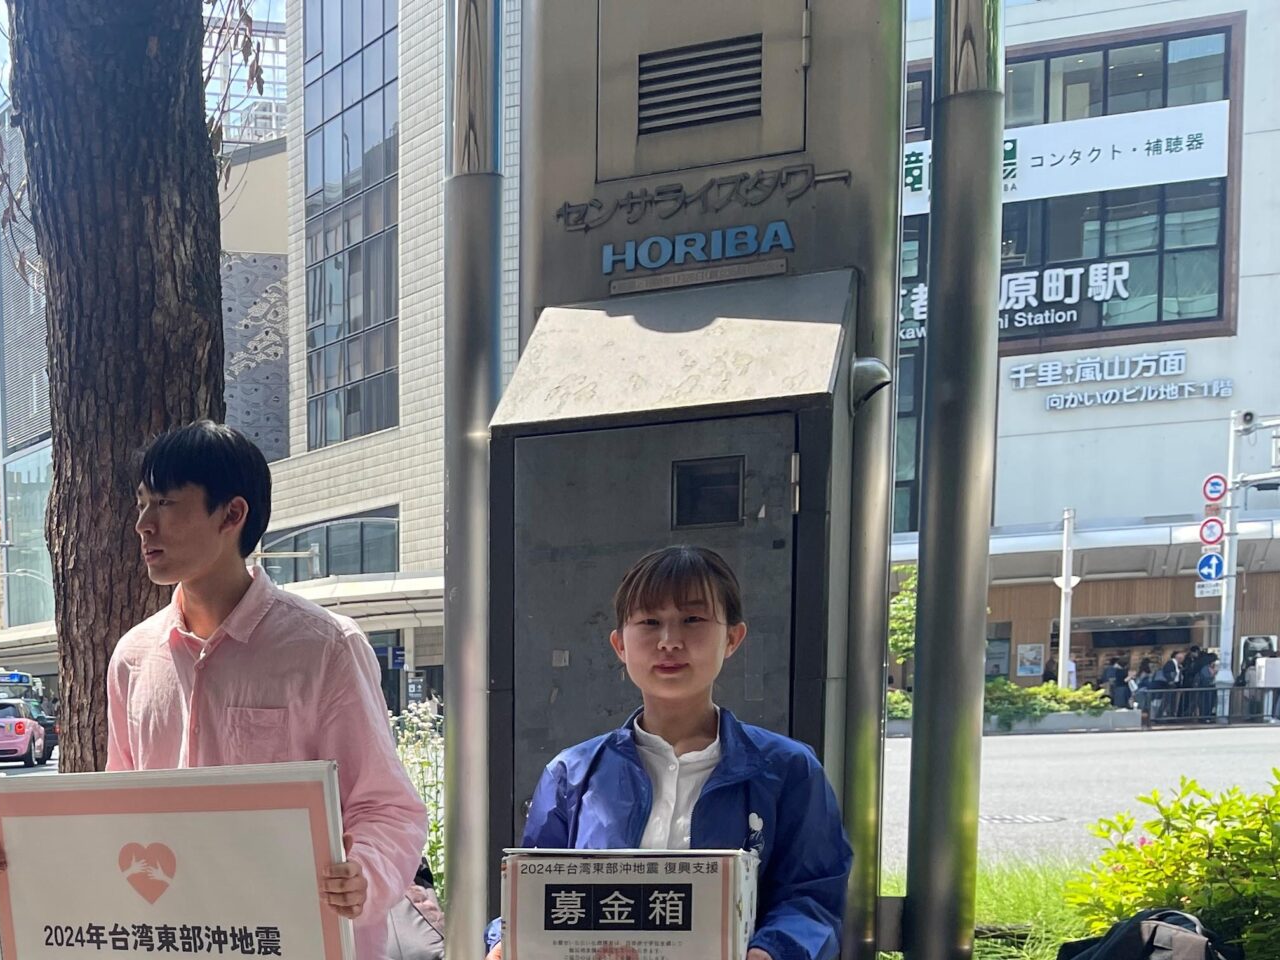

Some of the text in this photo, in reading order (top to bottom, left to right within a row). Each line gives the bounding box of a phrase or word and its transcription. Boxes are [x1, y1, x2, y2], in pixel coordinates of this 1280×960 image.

[1029, 131, 1206, 170] コンタクト・補聴器
[602, 219, 795, 275] HORIBA
[1014, 308, 1078, 328] Station
[1009, 349, 1187, 390] 千里・嵐山方面
[520, 861, 719, 875] 2024年台湾東部沖地震 復興支援
[550, 889, 686, 926] 募金箱
[43, 923, 283, 957] 2024年台湾東部沖地震
